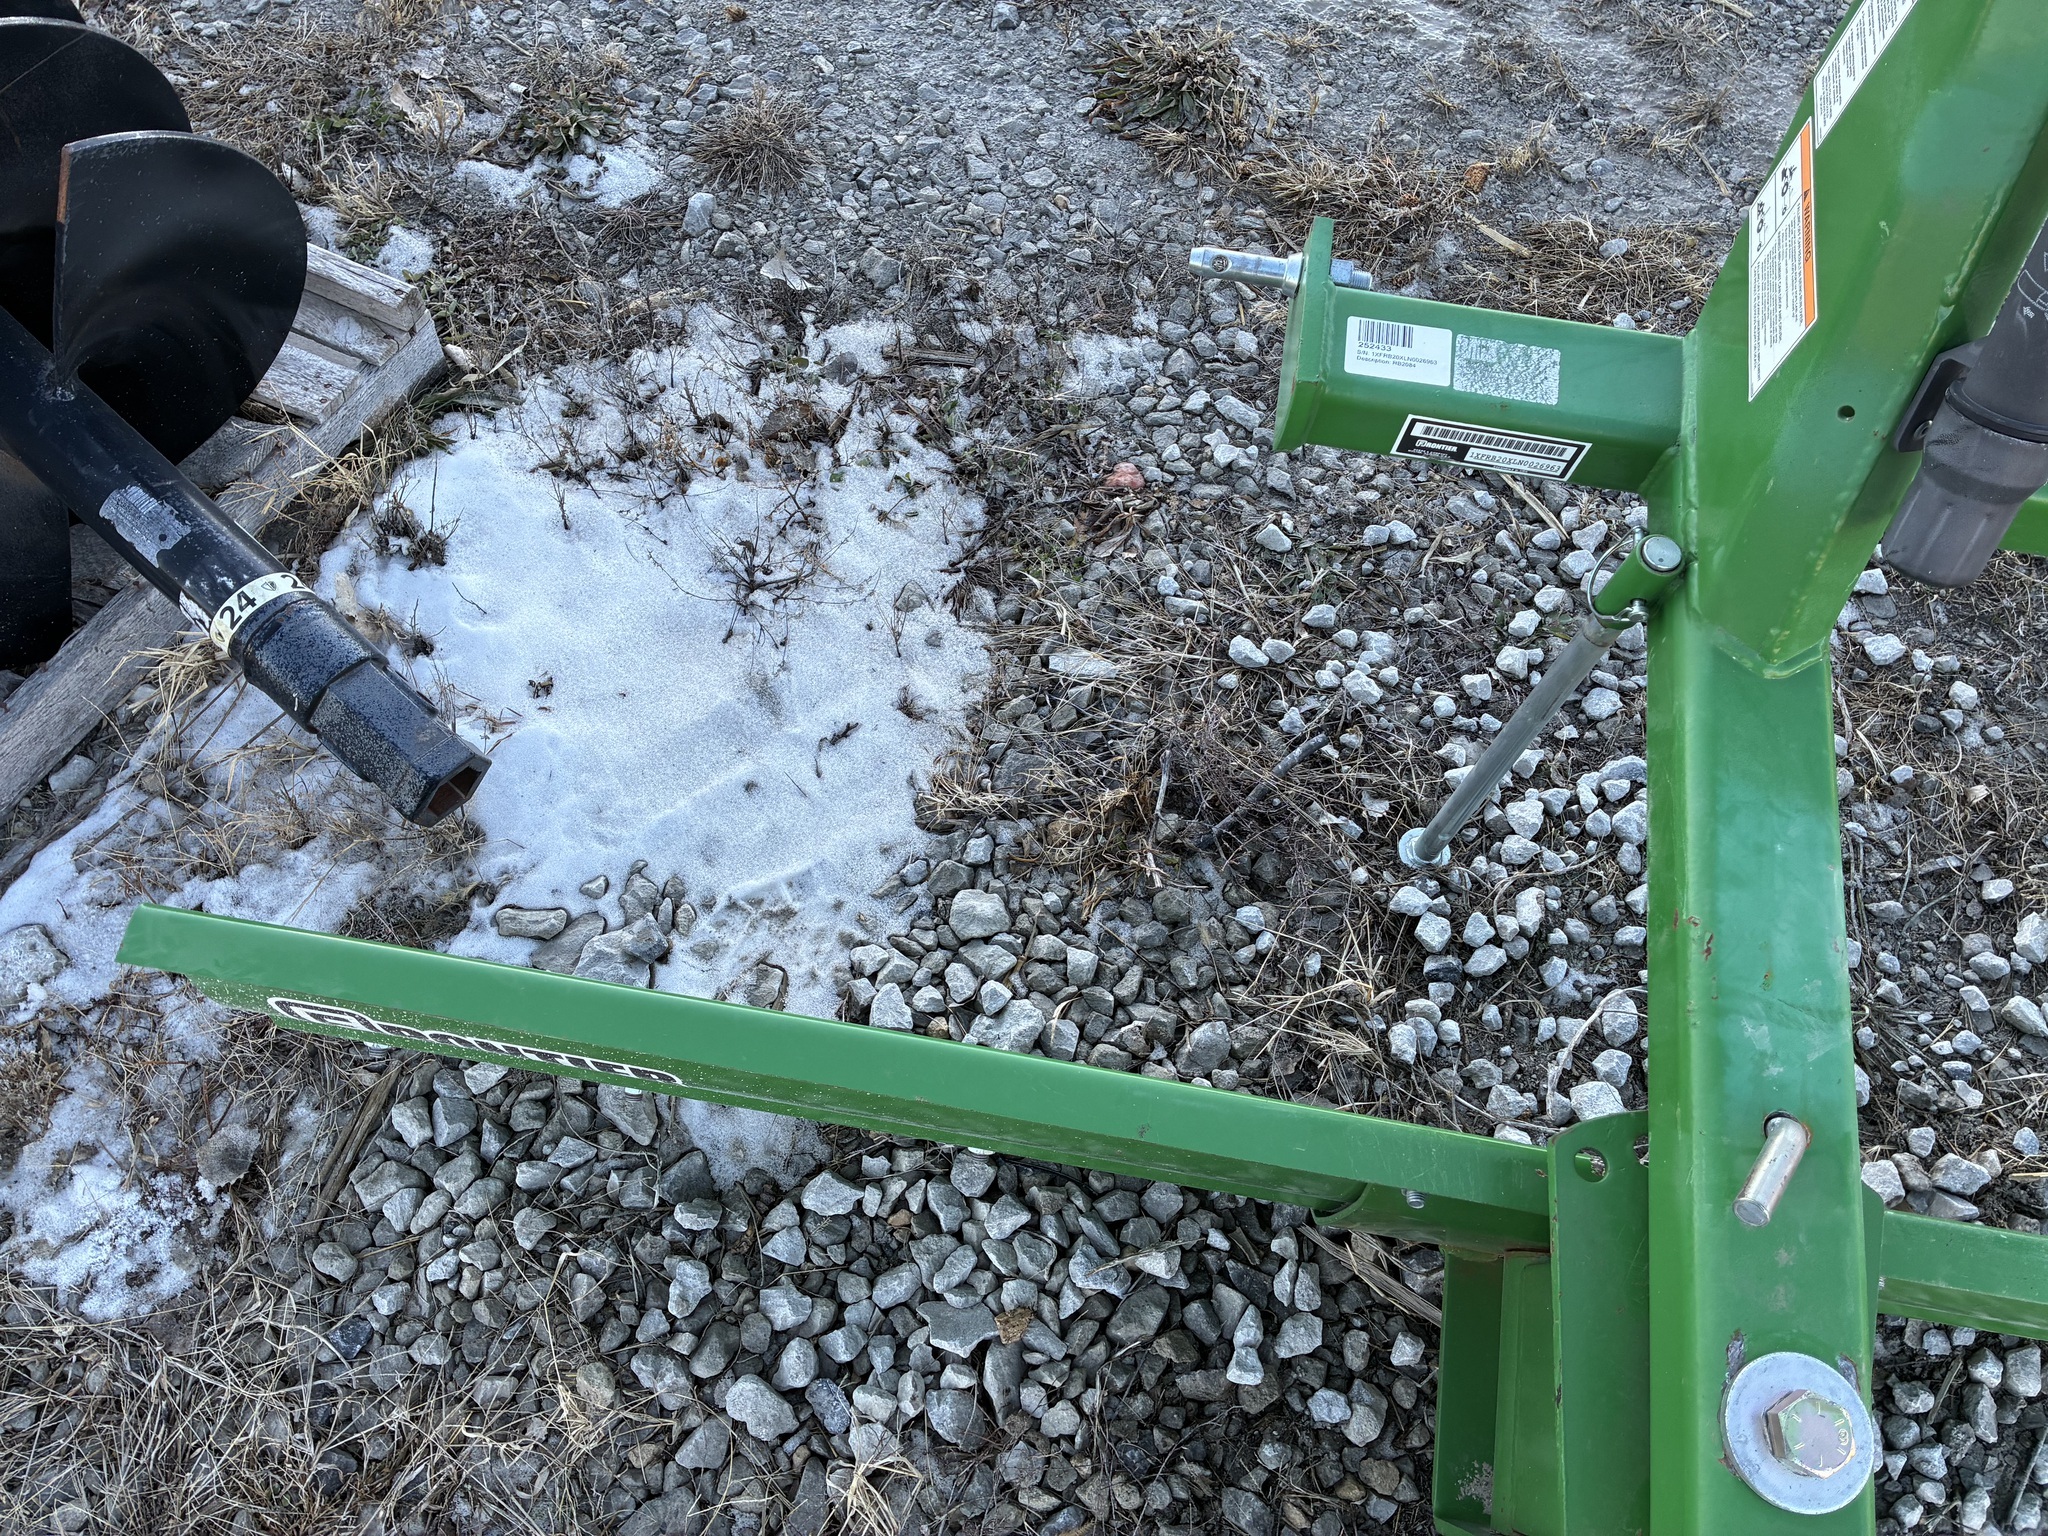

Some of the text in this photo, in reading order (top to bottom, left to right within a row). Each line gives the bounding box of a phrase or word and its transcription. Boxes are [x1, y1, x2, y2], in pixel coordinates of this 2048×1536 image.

[1803, 202, 1812, 263] WARNING
[1358, 341, 1392, 352] 252433
[1415, 439, 1458, 453] FRONTIER
[1468, 451, 1562, 473] 1XFRB20XLN0026963
[219, 590, 257, 631] 24
